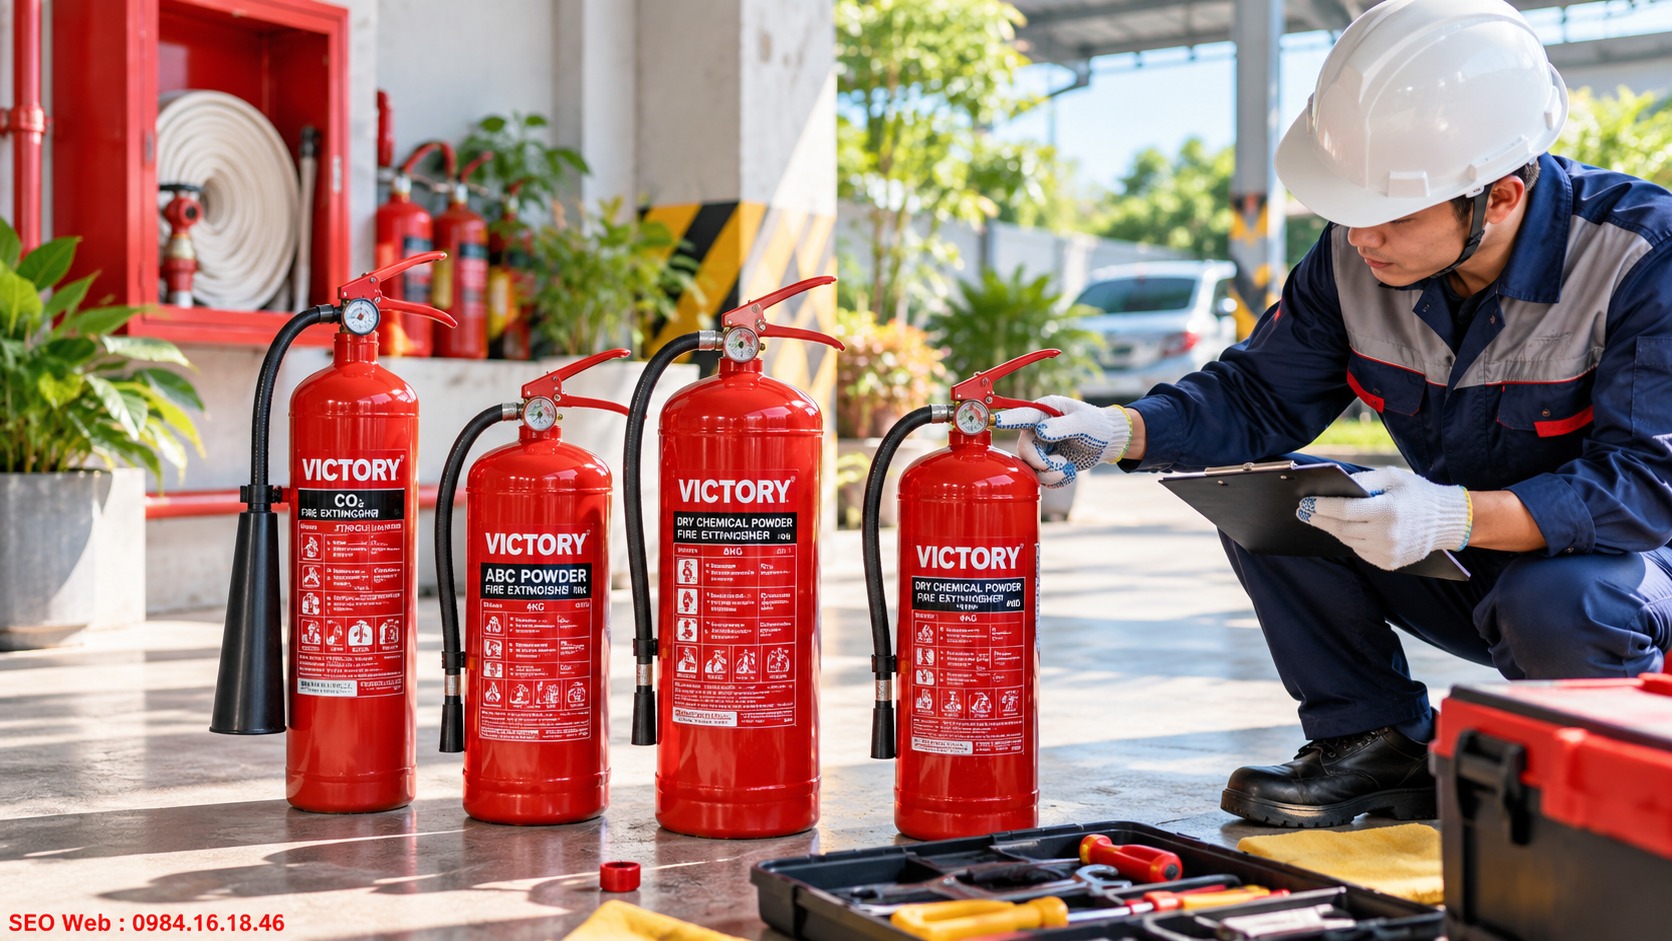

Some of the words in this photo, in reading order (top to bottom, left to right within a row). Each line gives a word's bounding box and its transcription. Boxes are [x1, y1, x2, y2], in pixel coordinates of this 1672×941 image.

[302, 458, 401, 481] VICTORY
[678, 479, 791, 504] VICTORY
[677, 517, 694, 527] DRY
[696, 517, 749, 528] CHEMICAL
[751, 518, 793, 528] POWDER
[677, 530, 697, 540] FIRE
[485, 532, 587, 556] VICTORY
[916, 545, 1020, 570] VICTORY
[485, 568, 516, 583] ABC
[520, 569, 587, 584] POWDER
[485, 585, 504, 595] FIRE
[915, 581, 932, 592] DRY
[933, 582, 983, 593] CHEMICAL
[985, 583, 1021, 593] POWDER
